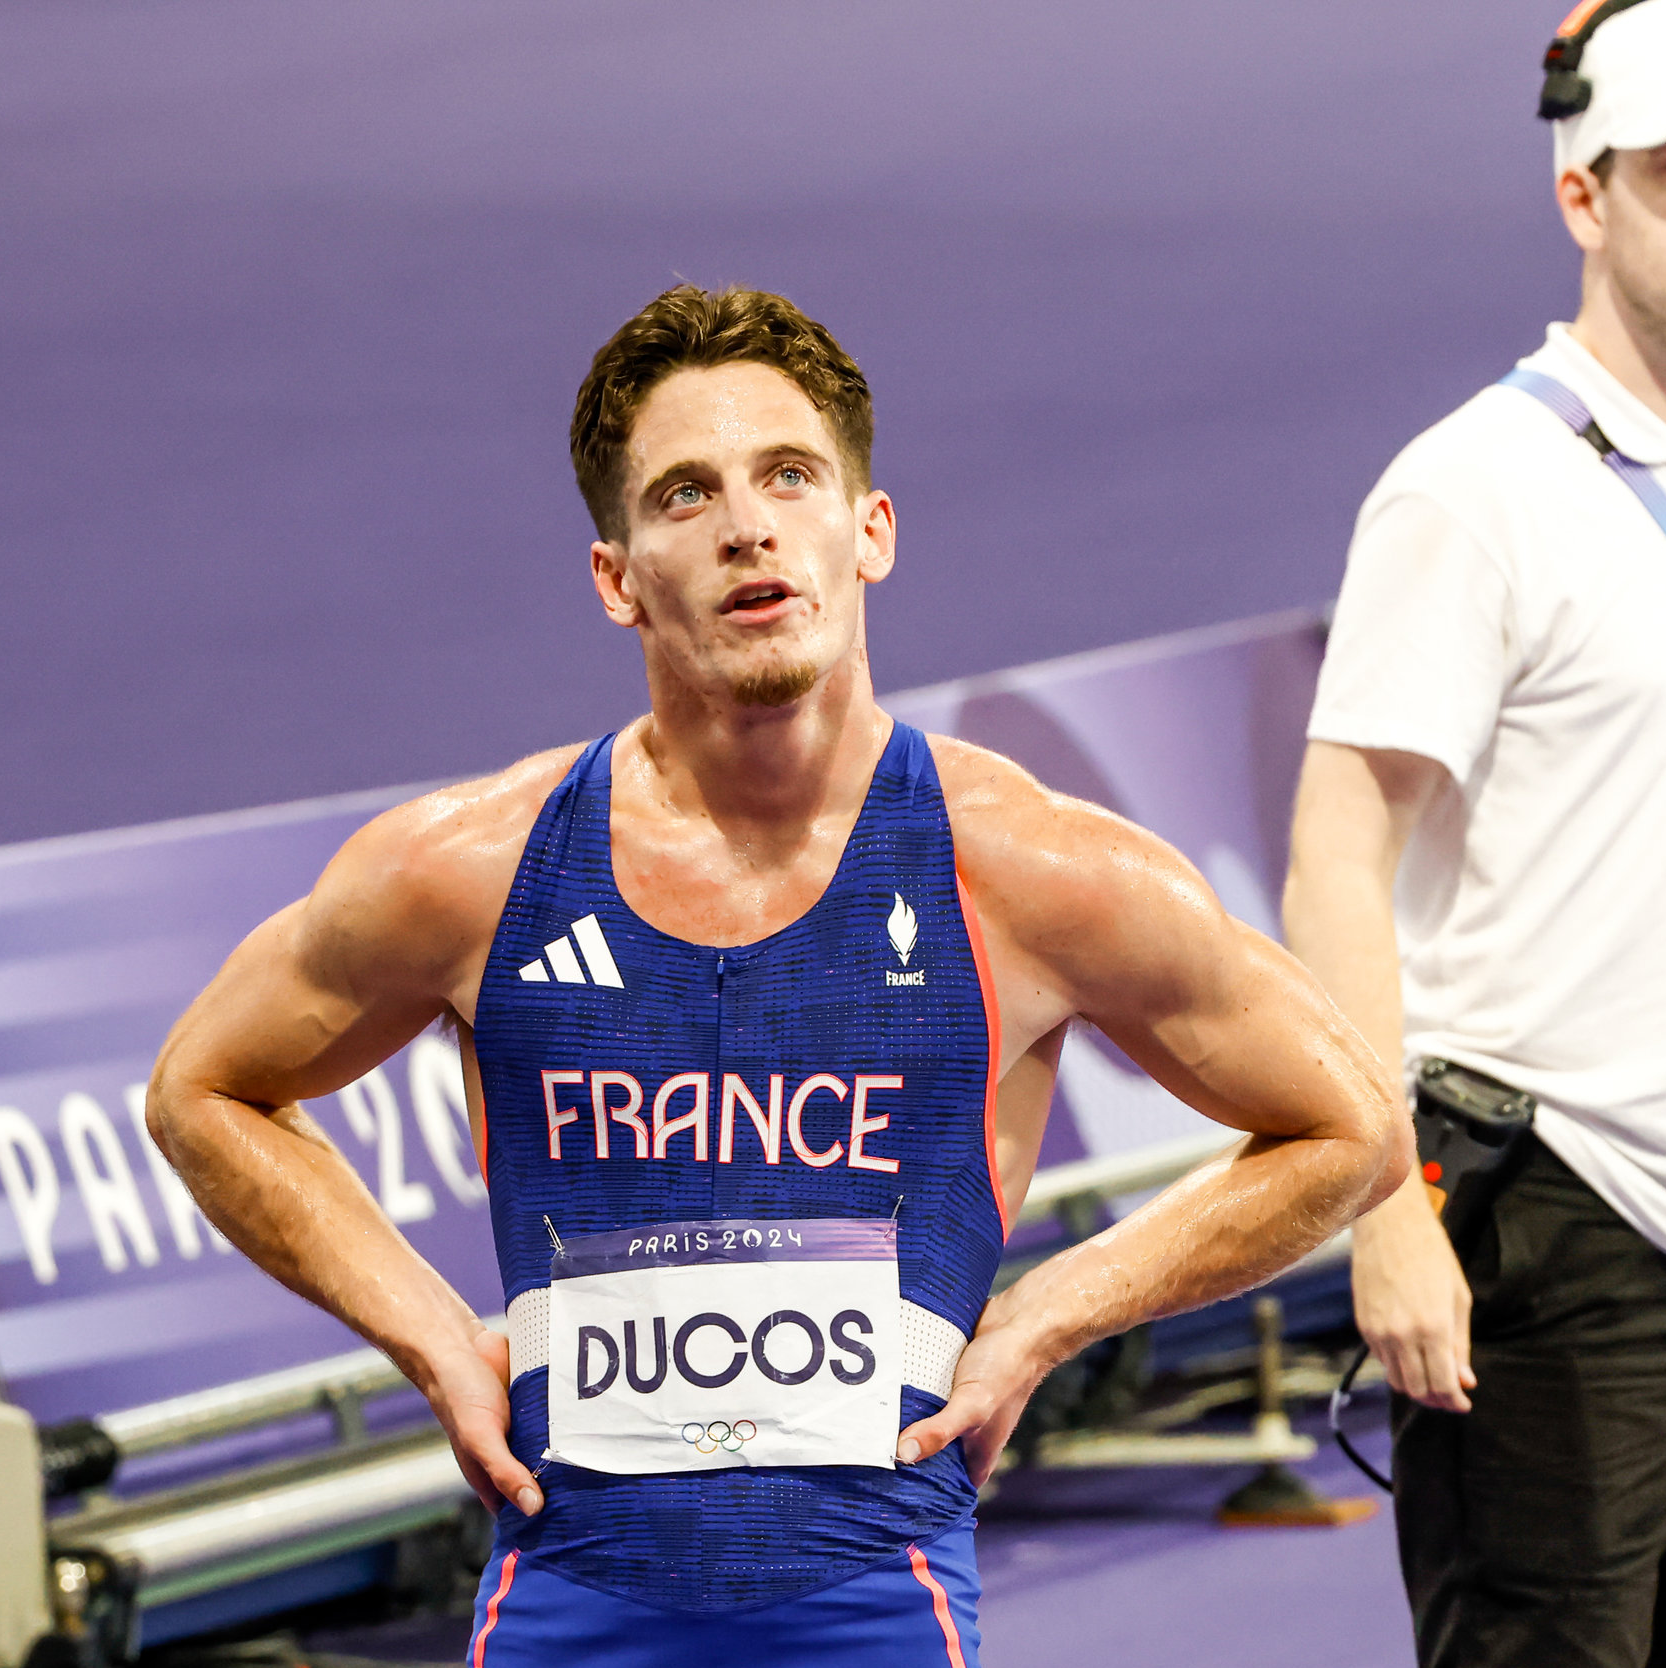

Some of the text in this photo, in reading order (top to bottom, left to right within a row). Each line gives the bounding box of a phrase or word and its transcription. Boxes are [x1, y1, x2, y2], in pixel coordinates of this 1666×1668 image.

[886, 969, 925, 987] FRANCE
[541, 1070, 903, 1173] FRANCE
[723, 1229, 803, 1250] 2024
[577, 1309, 876, 1400] DUCOS
